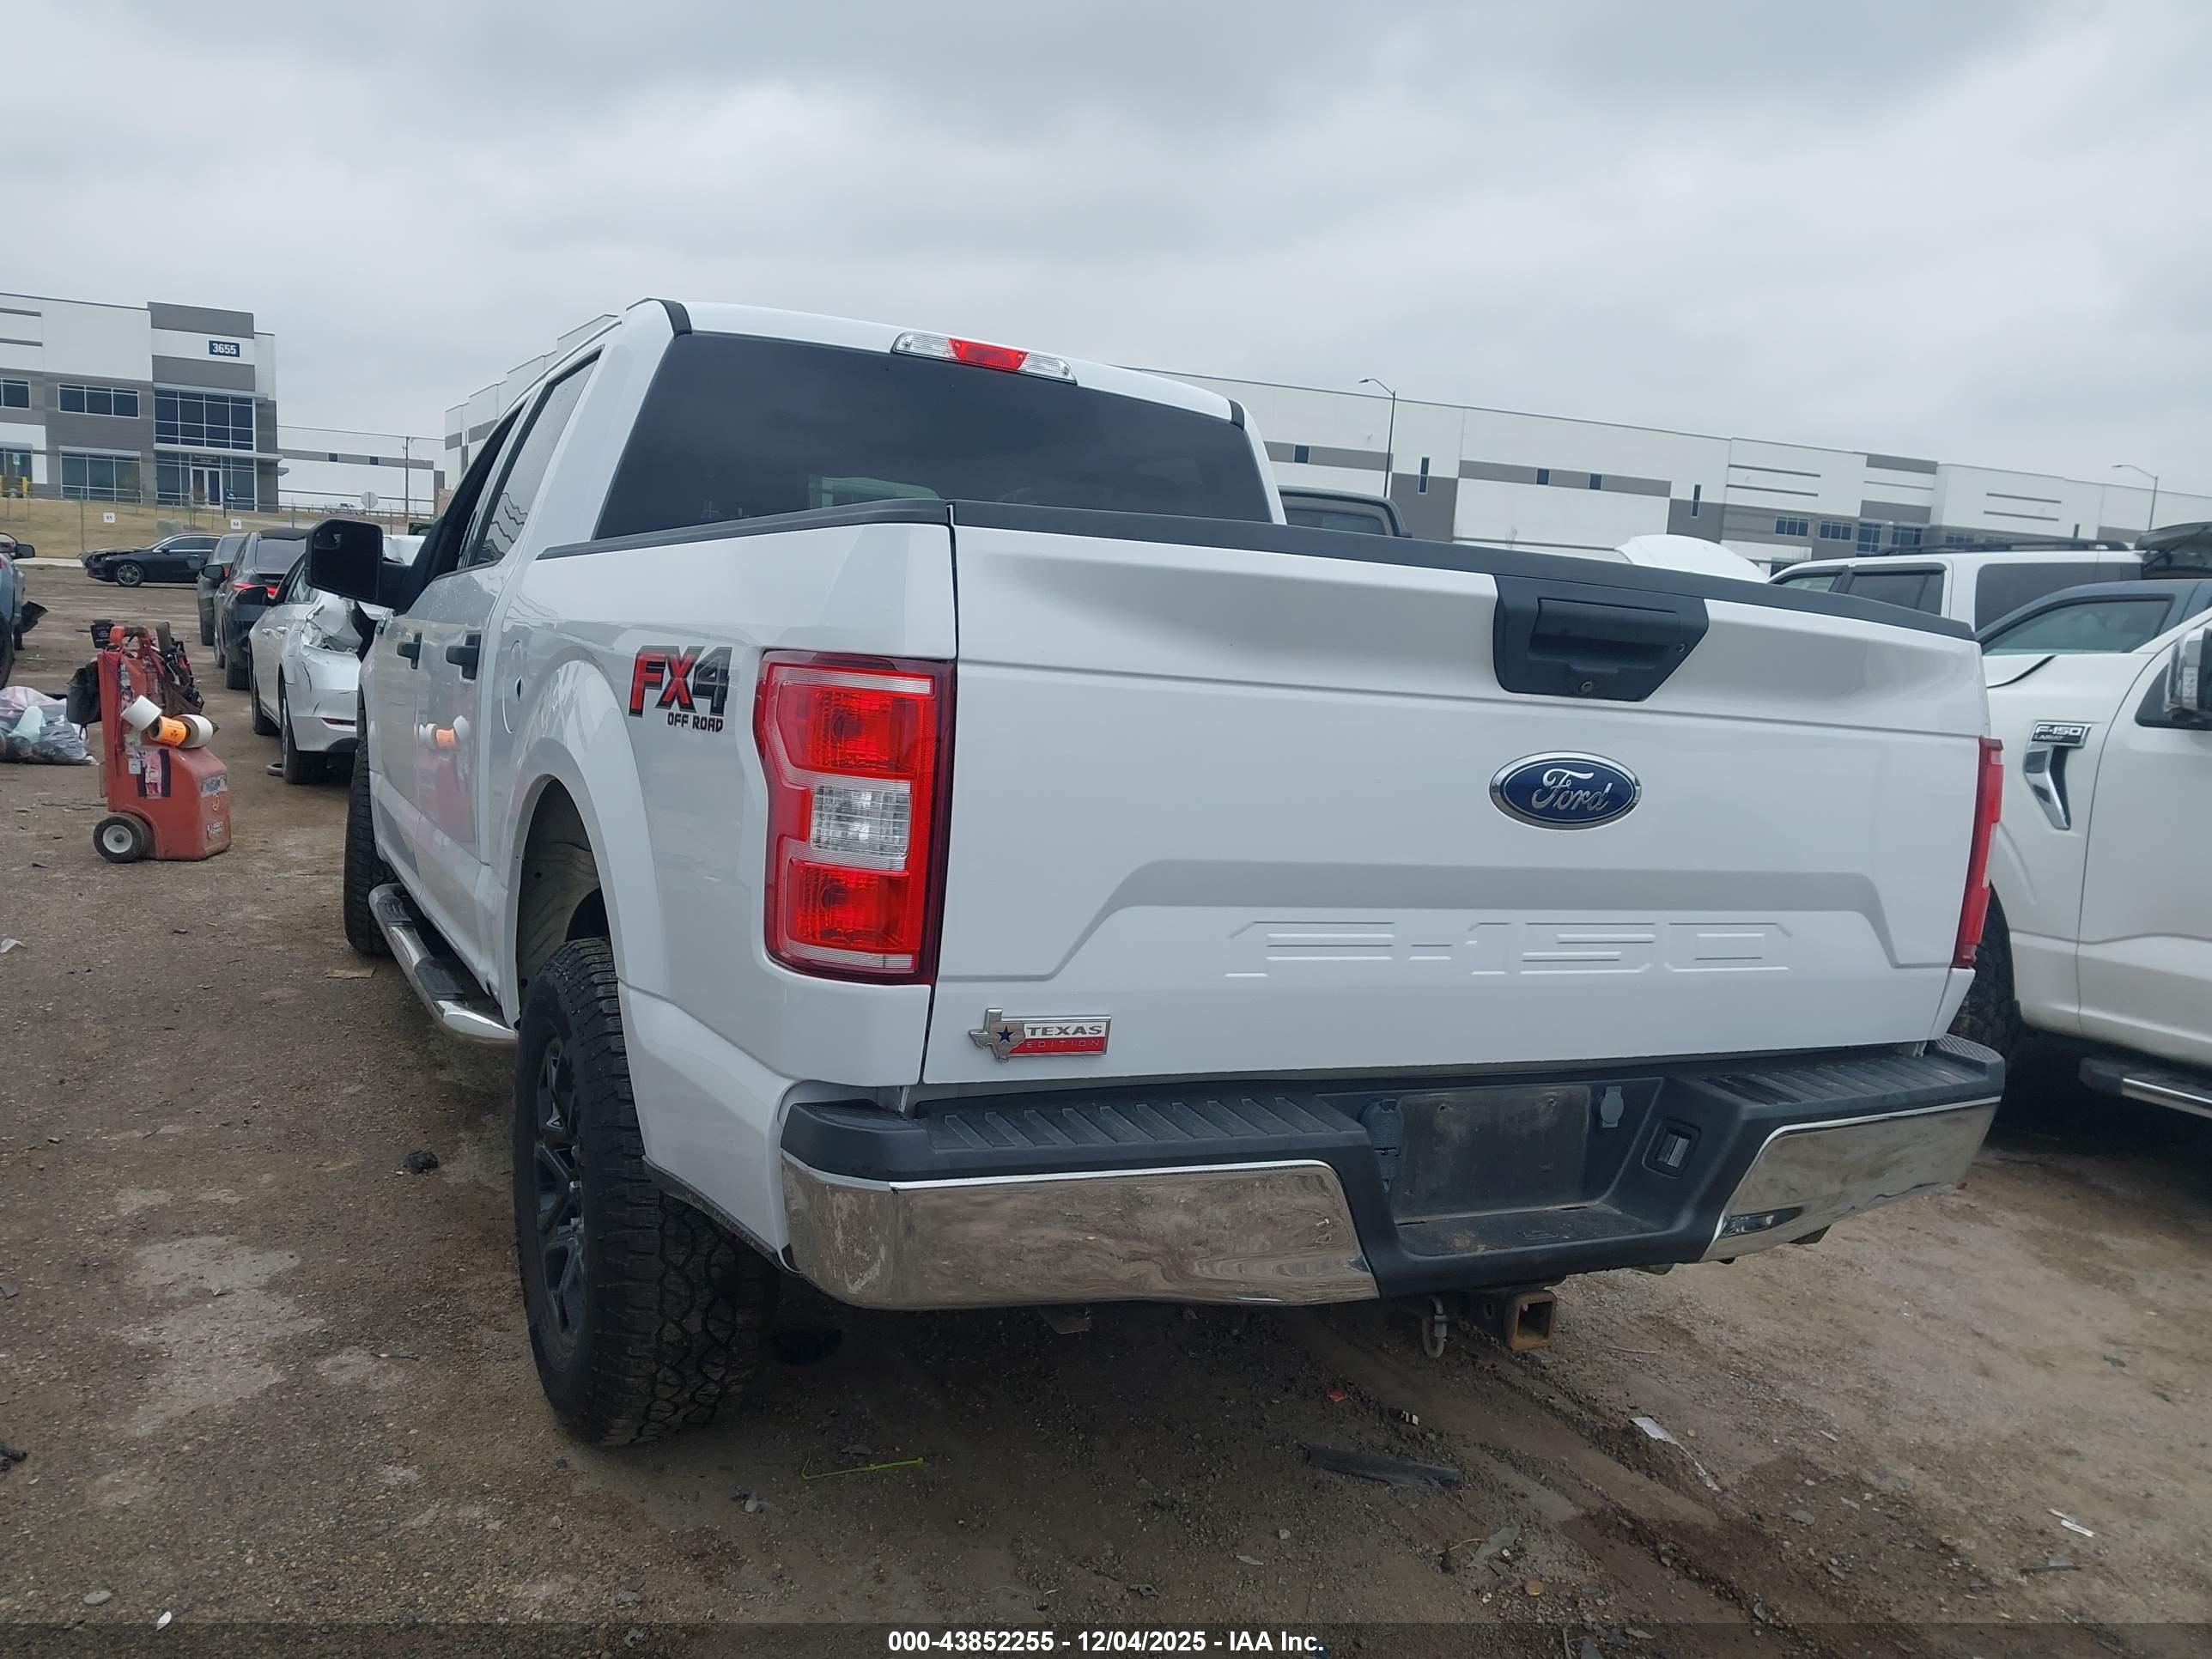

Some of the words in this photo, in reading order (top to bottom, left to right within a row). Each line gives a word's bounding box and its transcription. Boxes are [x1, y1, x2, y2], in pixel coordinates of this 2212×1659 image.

[212, 343, 237, 355] 3655
[628, 645, 733, 718] FX4
[666, 712, 689, 728] OFF
[691, 715, 724, 732] ROAD
[2035, 725, 2083, 737] F-150
[1531, 768, 1613, 811] Ford
[1026, 1025, 1103, 1037] TEXAS
[1026, 1039, 1100, 1048] EDITION
